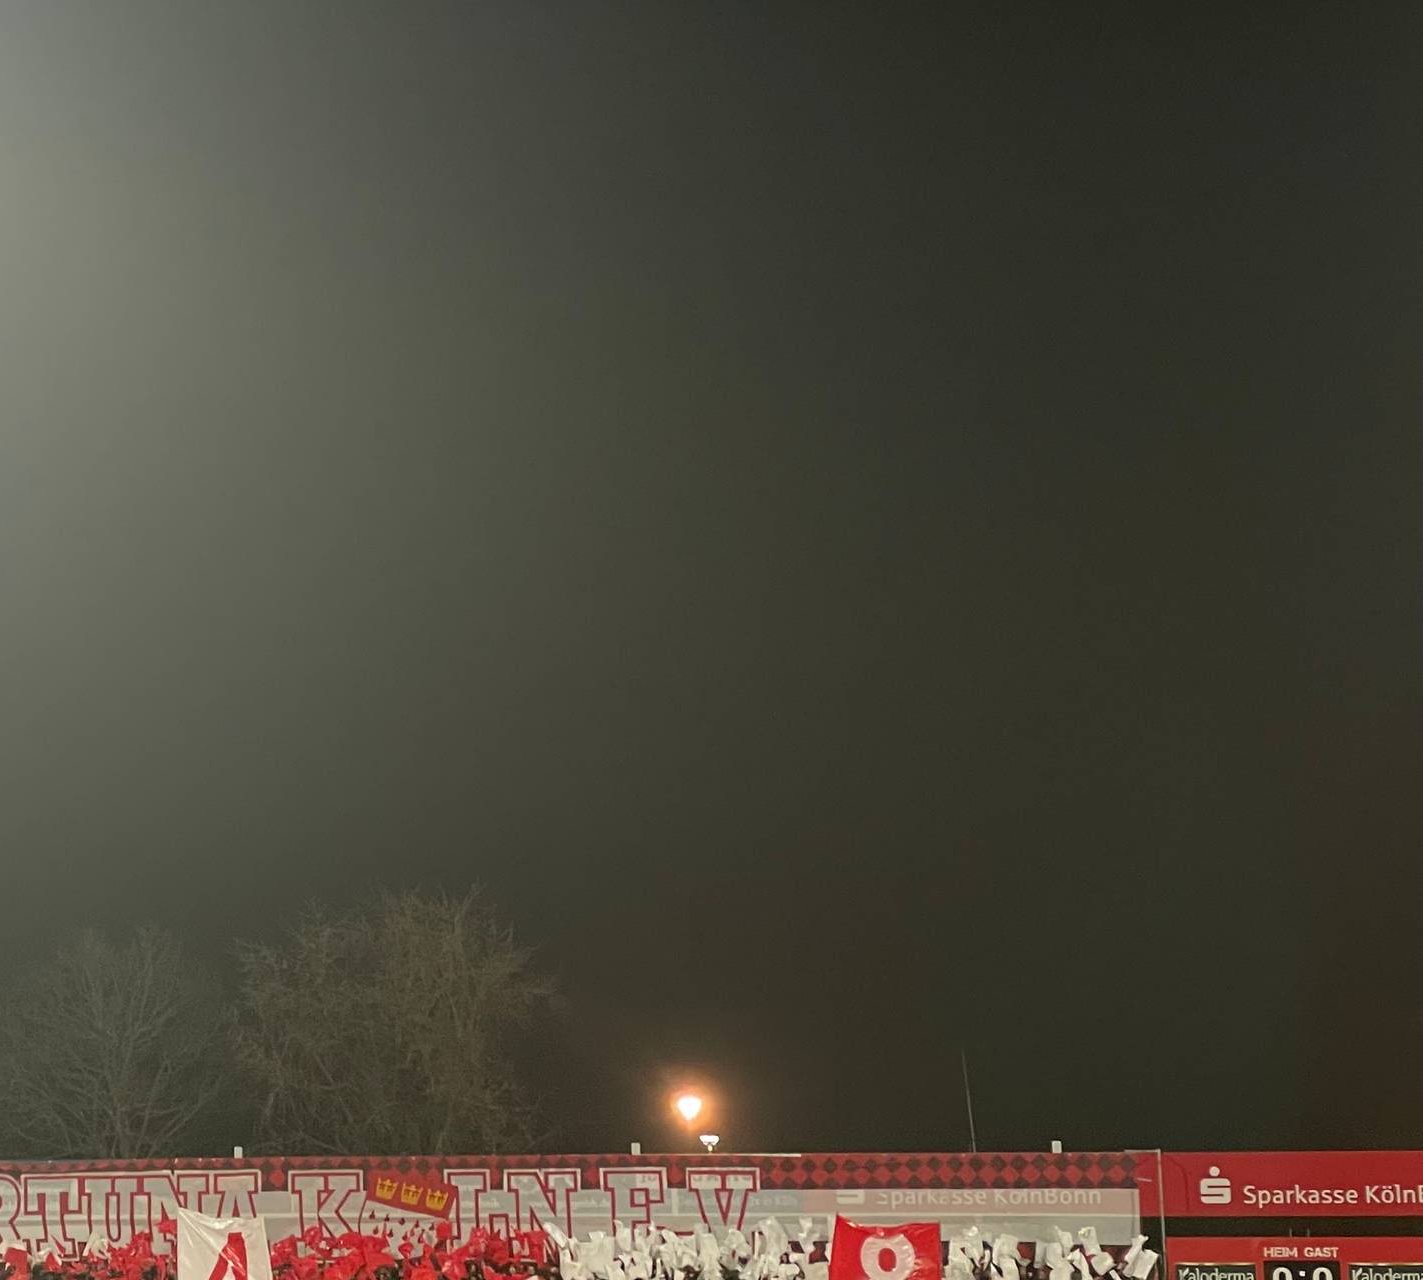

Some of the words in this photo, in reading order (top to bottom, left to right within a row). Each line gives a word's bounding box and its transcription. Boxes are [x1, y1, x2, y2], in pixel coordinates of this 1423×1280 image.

[1242, 1184, 1358, 1209] Sparkasse
[288, 1168, 581, 1263] KLN
[1263, 1246, 1298, 1257] HEIM
[1304, 1246, 1339, 1257] GAST
